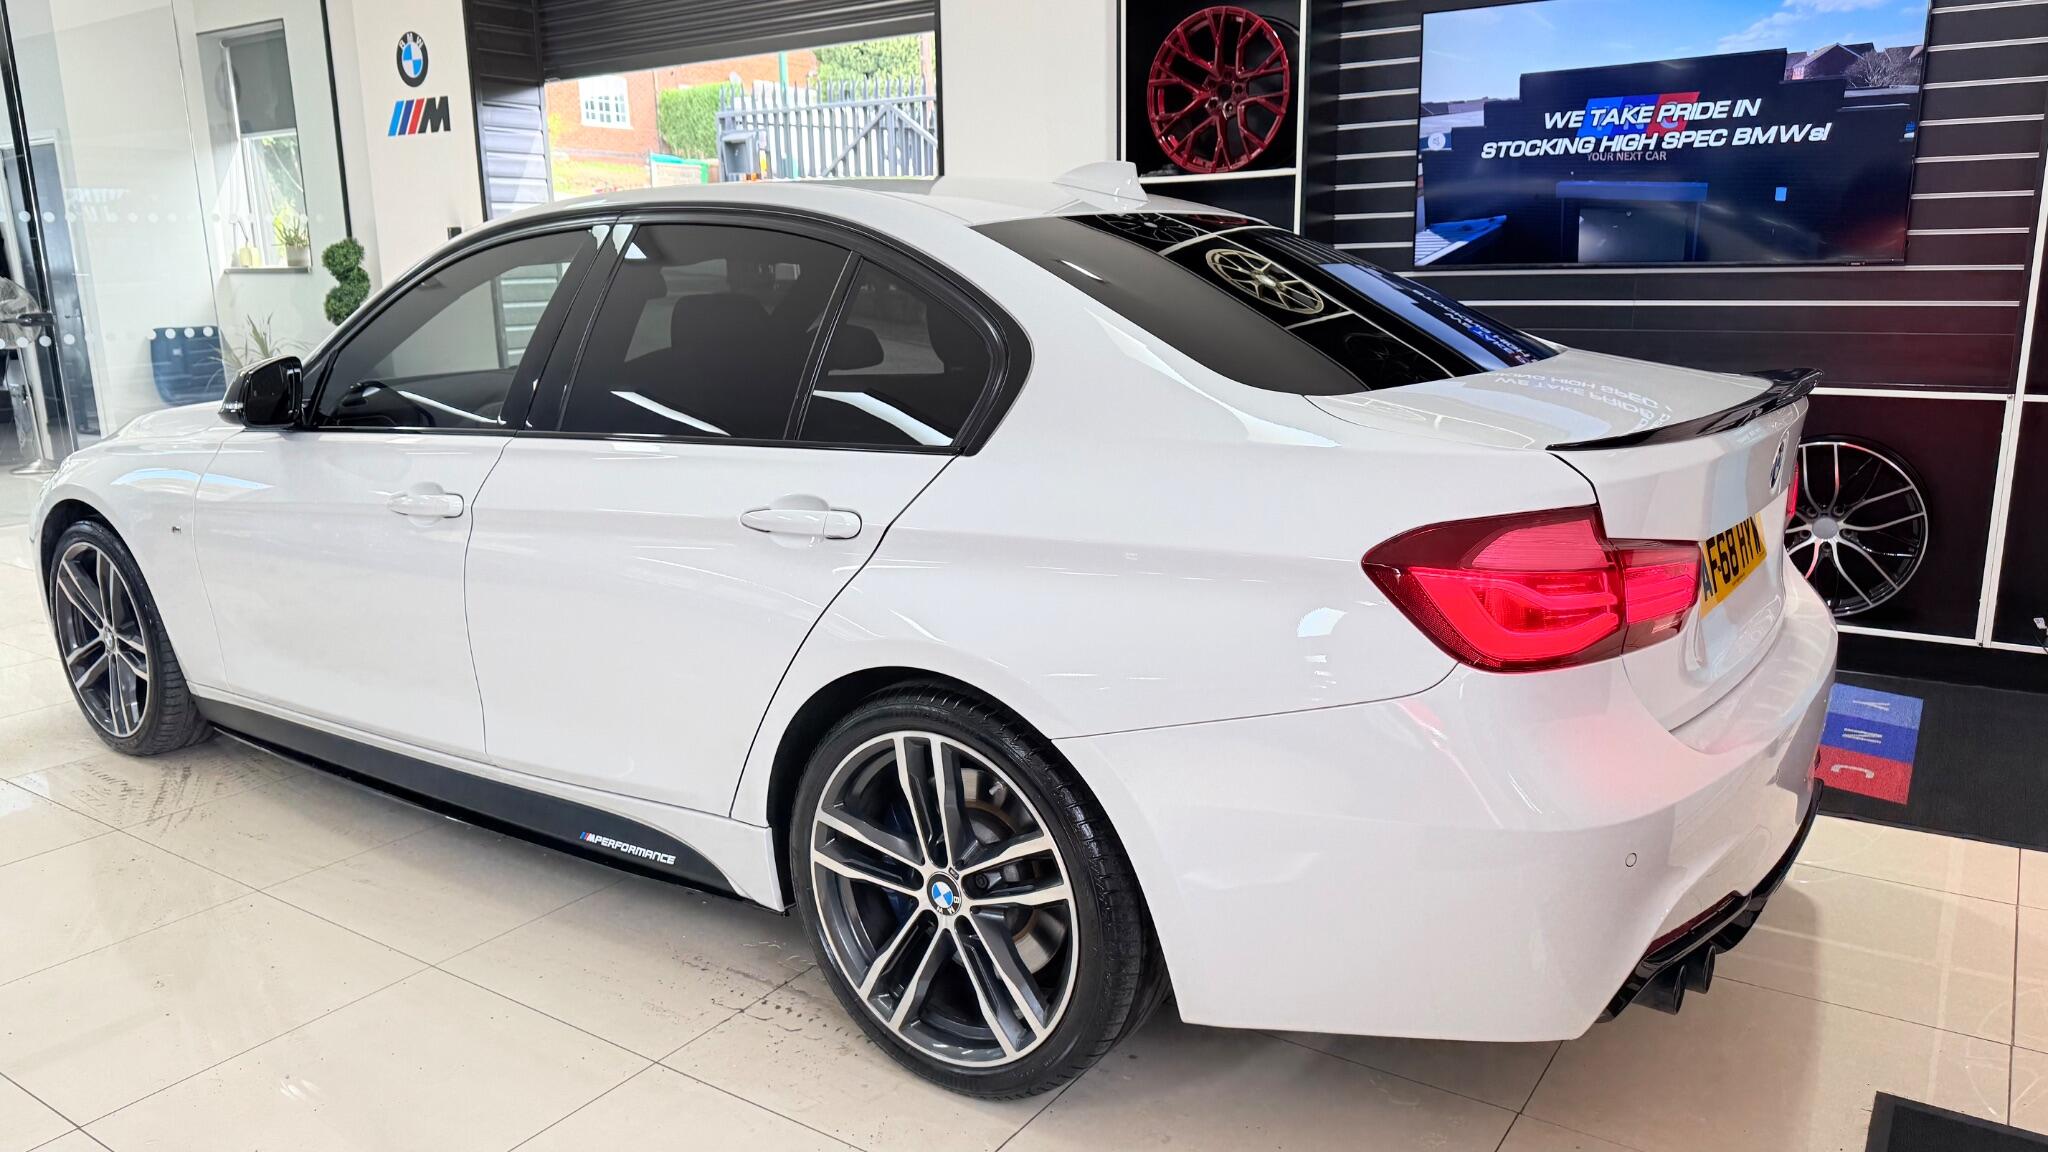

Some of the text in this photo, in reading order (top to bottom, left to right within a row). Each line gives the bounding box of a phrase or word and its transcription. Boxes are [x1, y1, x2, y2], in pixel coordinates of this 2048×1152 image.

[1545, 110, 1586, 129] WE
[1590, 105, 1655, 126] TAKE
[1656, 100, 1731, 122] PRIDE
[1732, 98, 1762, 117] IN
[1481, 136, 1596, 159] STOCKING
[1599, 133, 1659, 152] HIGH
[1661, 129, 1728, 149] SPEC
[1587, 151, 1667, 161] YOUR NEXT CAR
[1702, 528, 1739, 602] AF68
